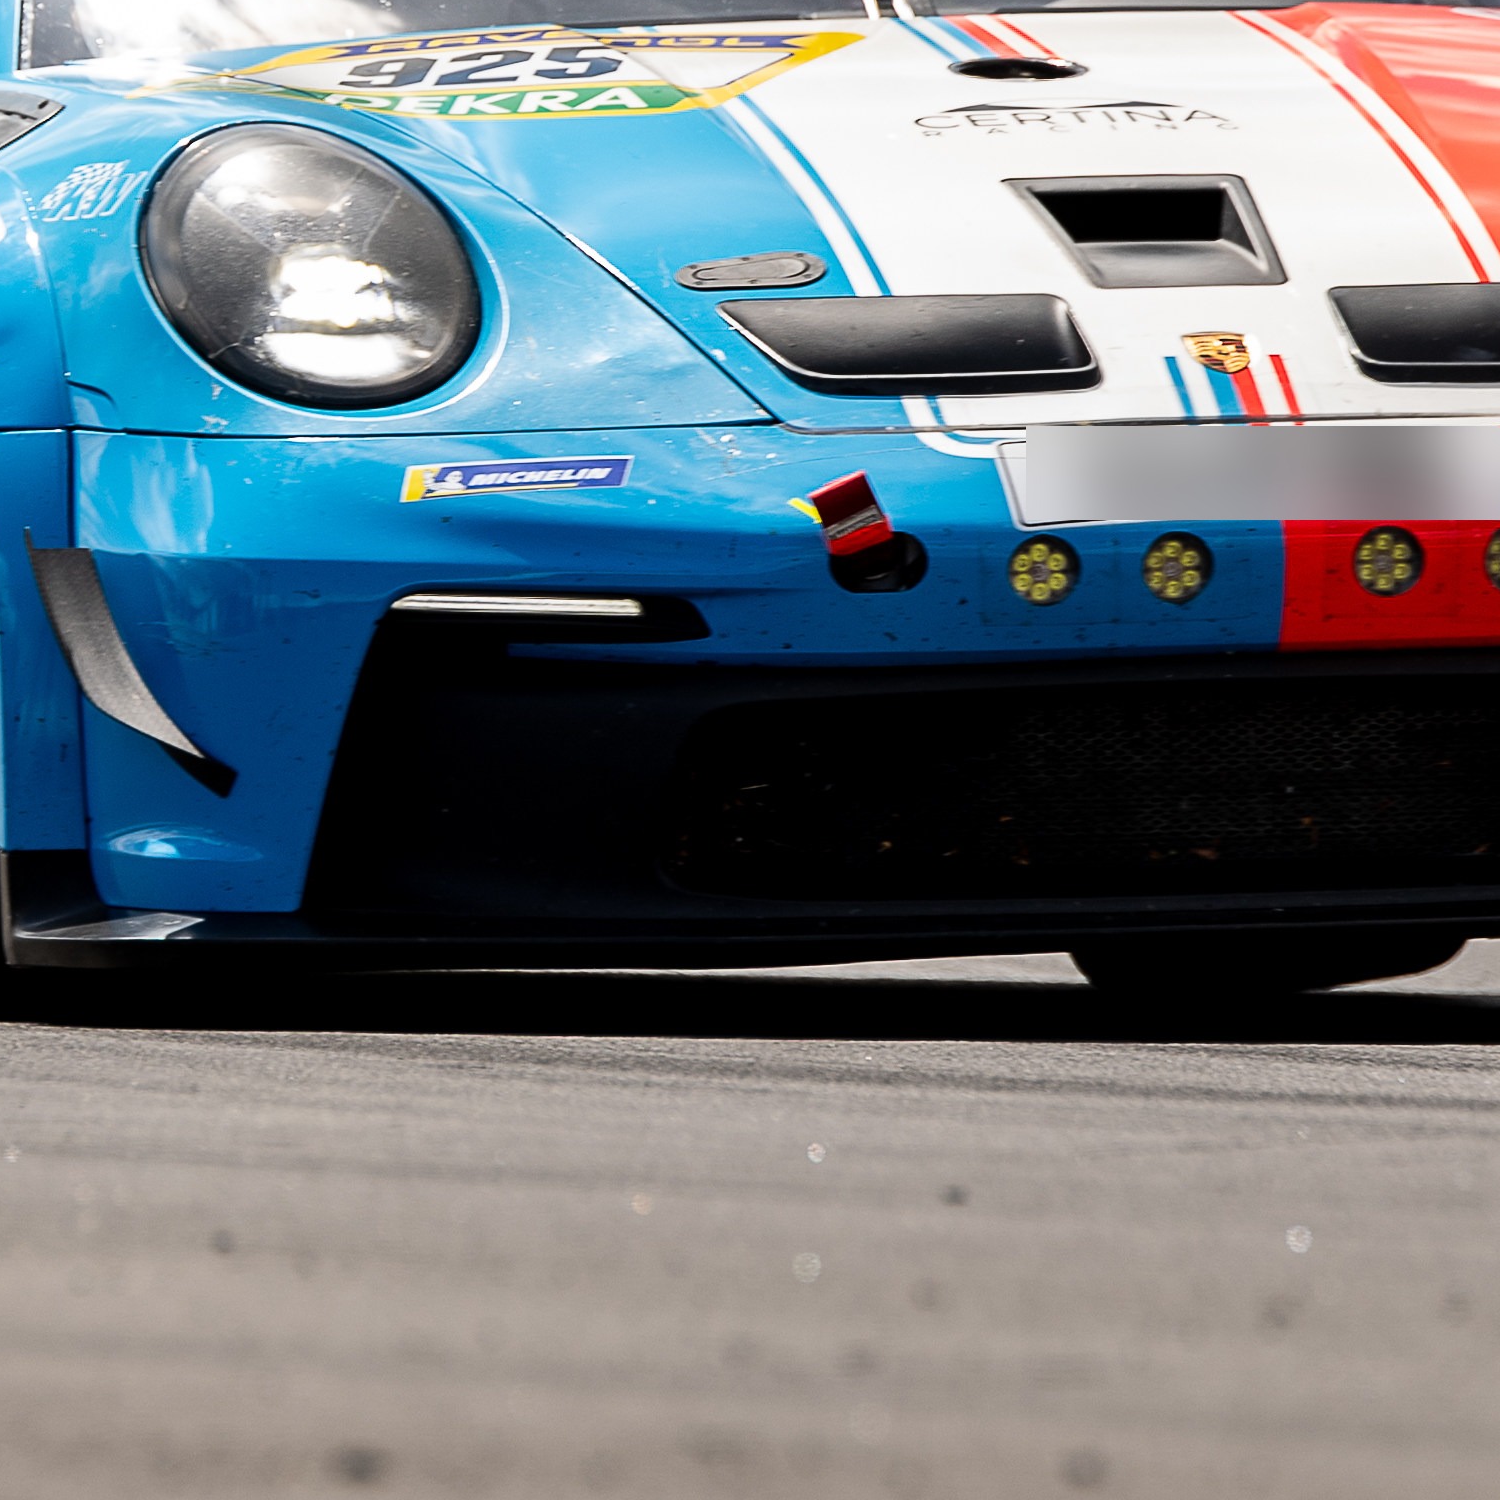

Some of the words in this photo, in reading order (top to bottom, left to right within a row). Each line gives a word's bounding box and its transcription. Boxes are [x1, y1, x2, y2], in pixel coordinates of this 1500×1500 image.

[340, 47, 624, 87] 925
[324, 88, 649, 115] DEKRA
[914, 108, 1230, 130] CERTINA
[921, 122, 1240, 137] RACING
[468, 466, 613, 487] MICHELIN
